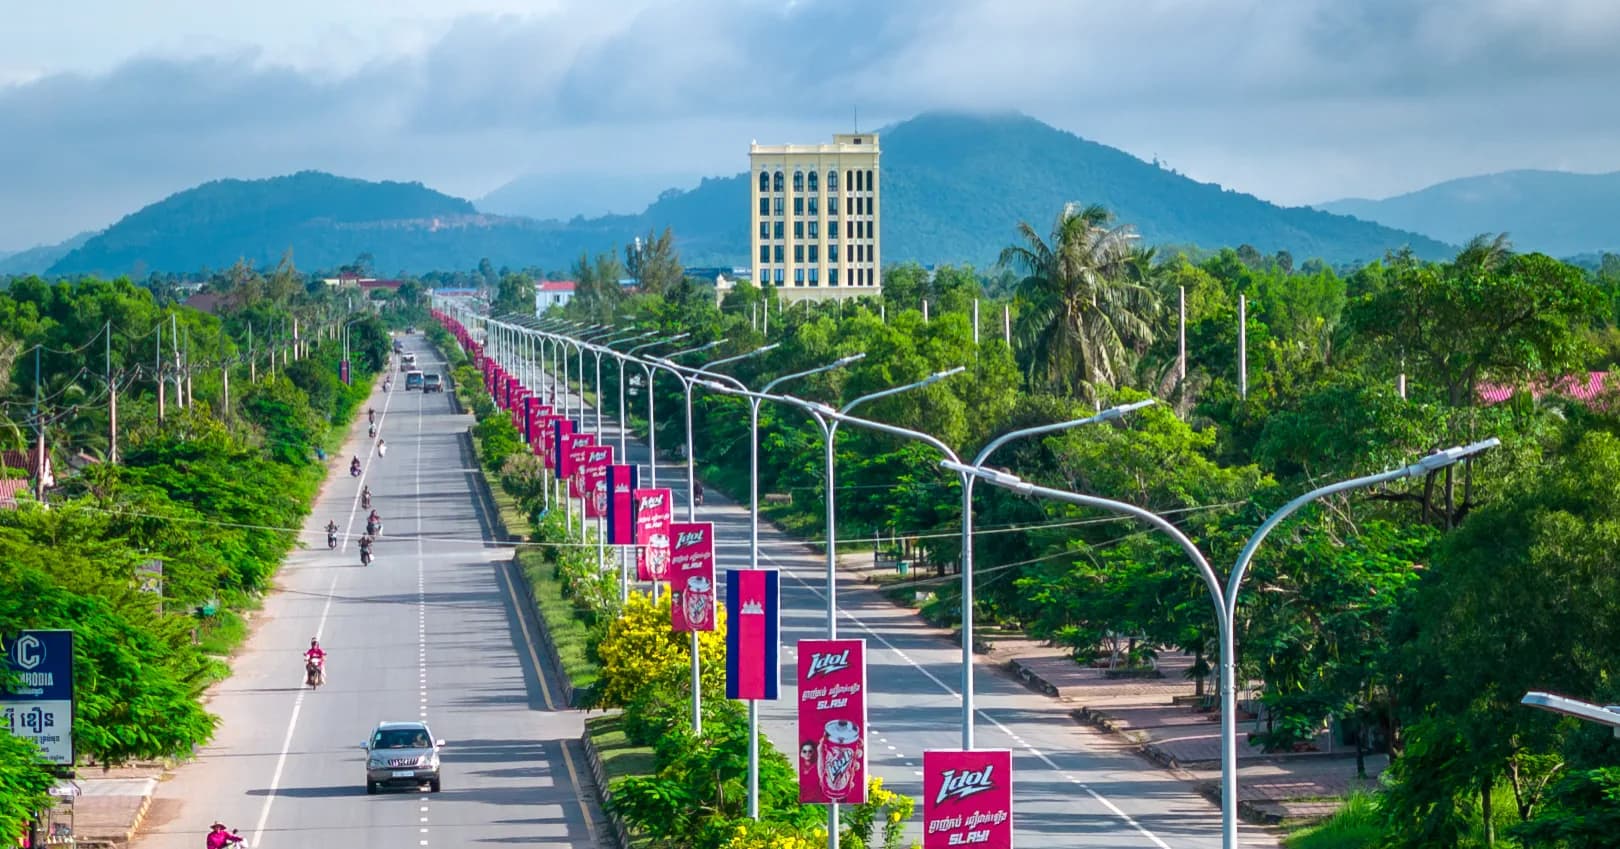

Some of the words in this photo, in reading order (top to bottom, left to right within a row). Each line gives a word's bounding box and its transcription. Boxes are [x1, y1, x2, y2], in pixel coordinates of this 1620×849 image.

[17, 634, 40, 670] C
[807, 649, 849, 679] Idol
[816, 697, 848, 710] SLAY!
[936, 765, 994, 804] Idol
[948, 830, 990, 846] SLAY!
